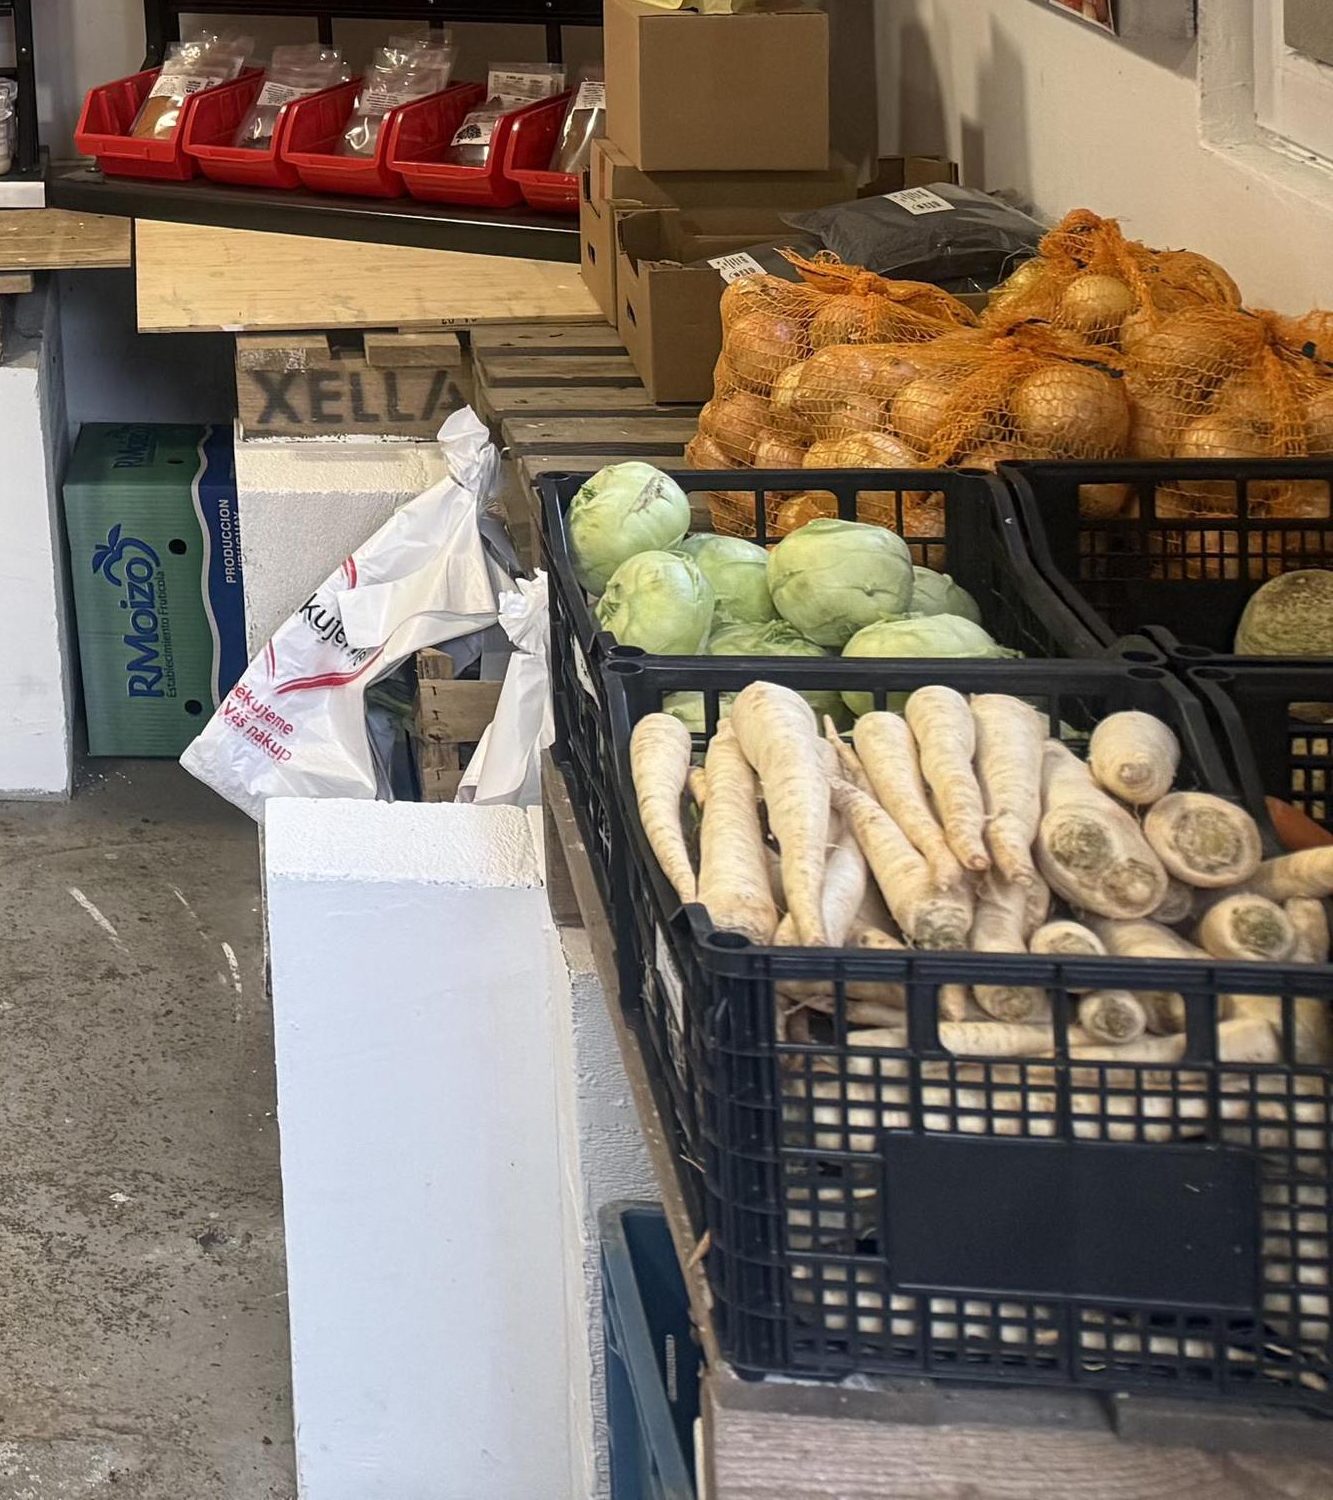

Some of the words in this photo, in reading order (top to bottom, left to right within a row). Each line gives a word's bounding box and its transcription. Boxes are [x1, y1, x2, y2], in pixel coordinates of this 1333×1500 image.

[251, 369, 468, 424] XELLA
[218, 499, 238, 584] PRODUCCION
[158, 616, 178, 699] Establecimiento
[223, 701, 251, 728] Váš
[246, 724, 293, 762] nákup
[233, 682, 294, 736] ěkujeme
